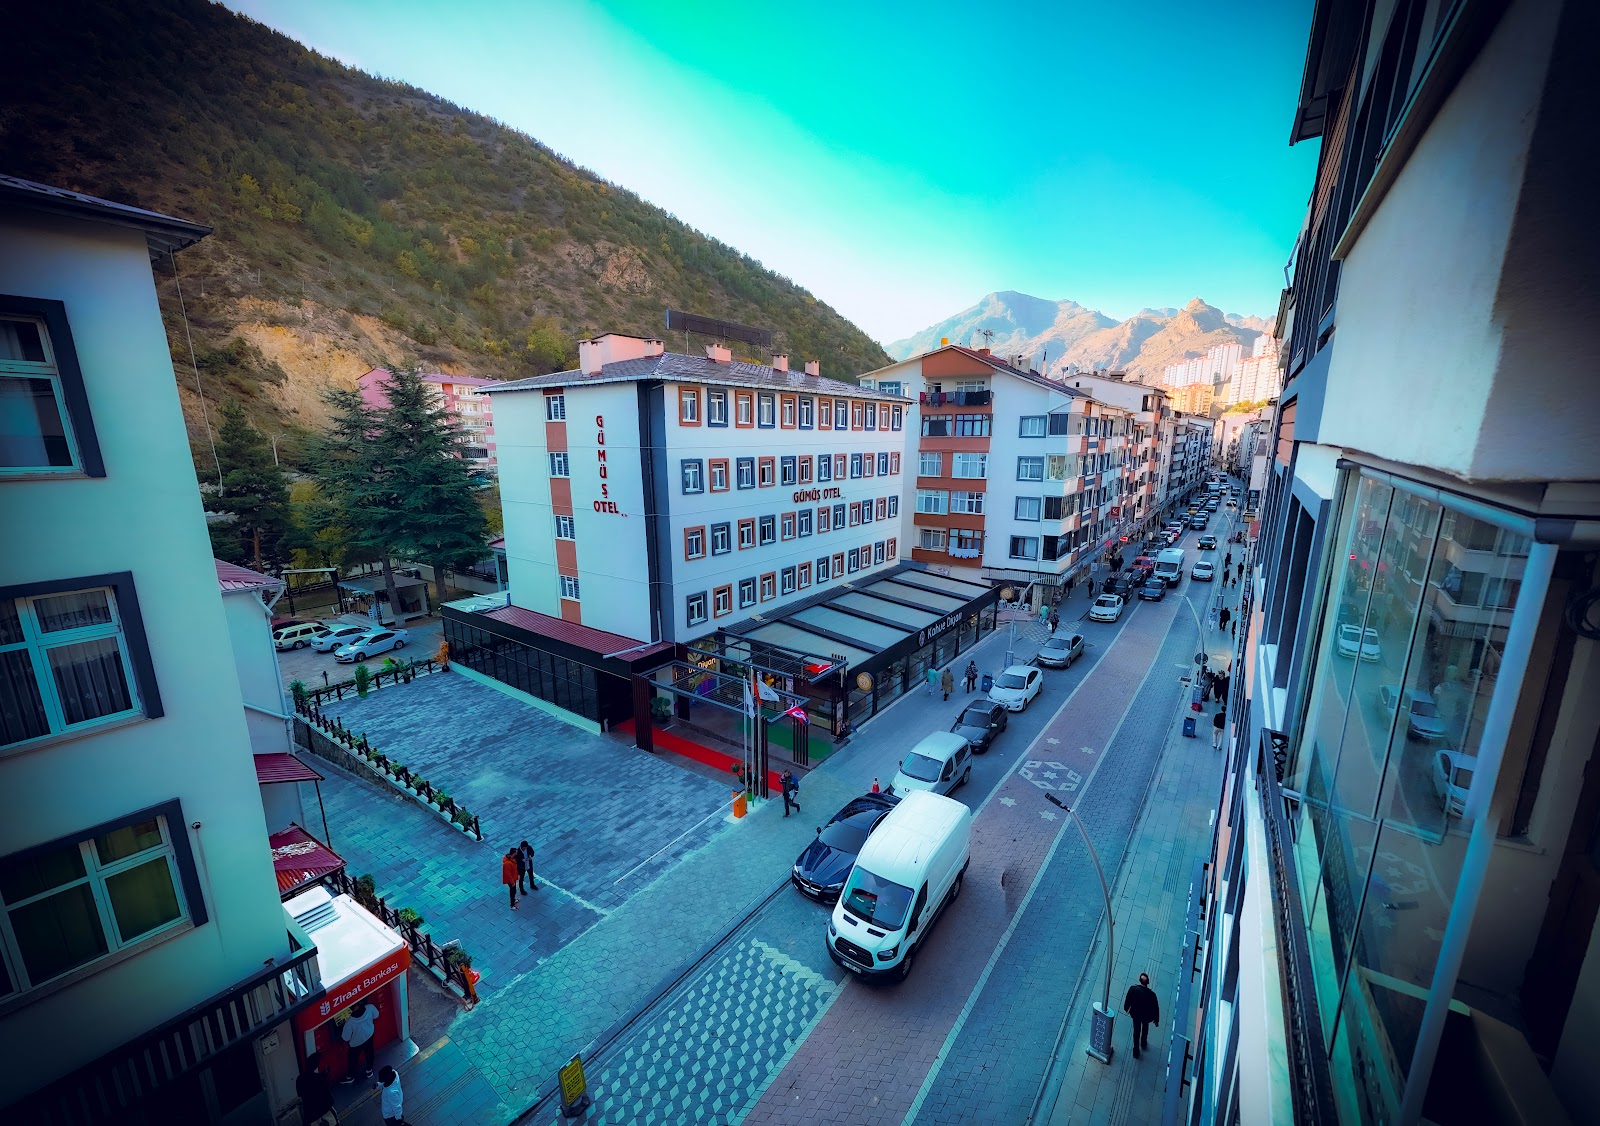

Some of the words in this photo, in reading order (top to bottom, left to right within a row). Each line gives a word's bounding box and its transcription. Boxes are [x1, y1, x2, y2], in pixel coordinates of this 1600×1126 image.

[595, 415, 608, 499] GÜMÜŞ
[593, 500, 620, 514] OTEL
[793, 487, 821, 504] GÜMÜŞ
[823, 487, 841, 500] OTEL
[332, 984, 362, 1008] Ziraat
[363, 962, 399, 988] Bankası
